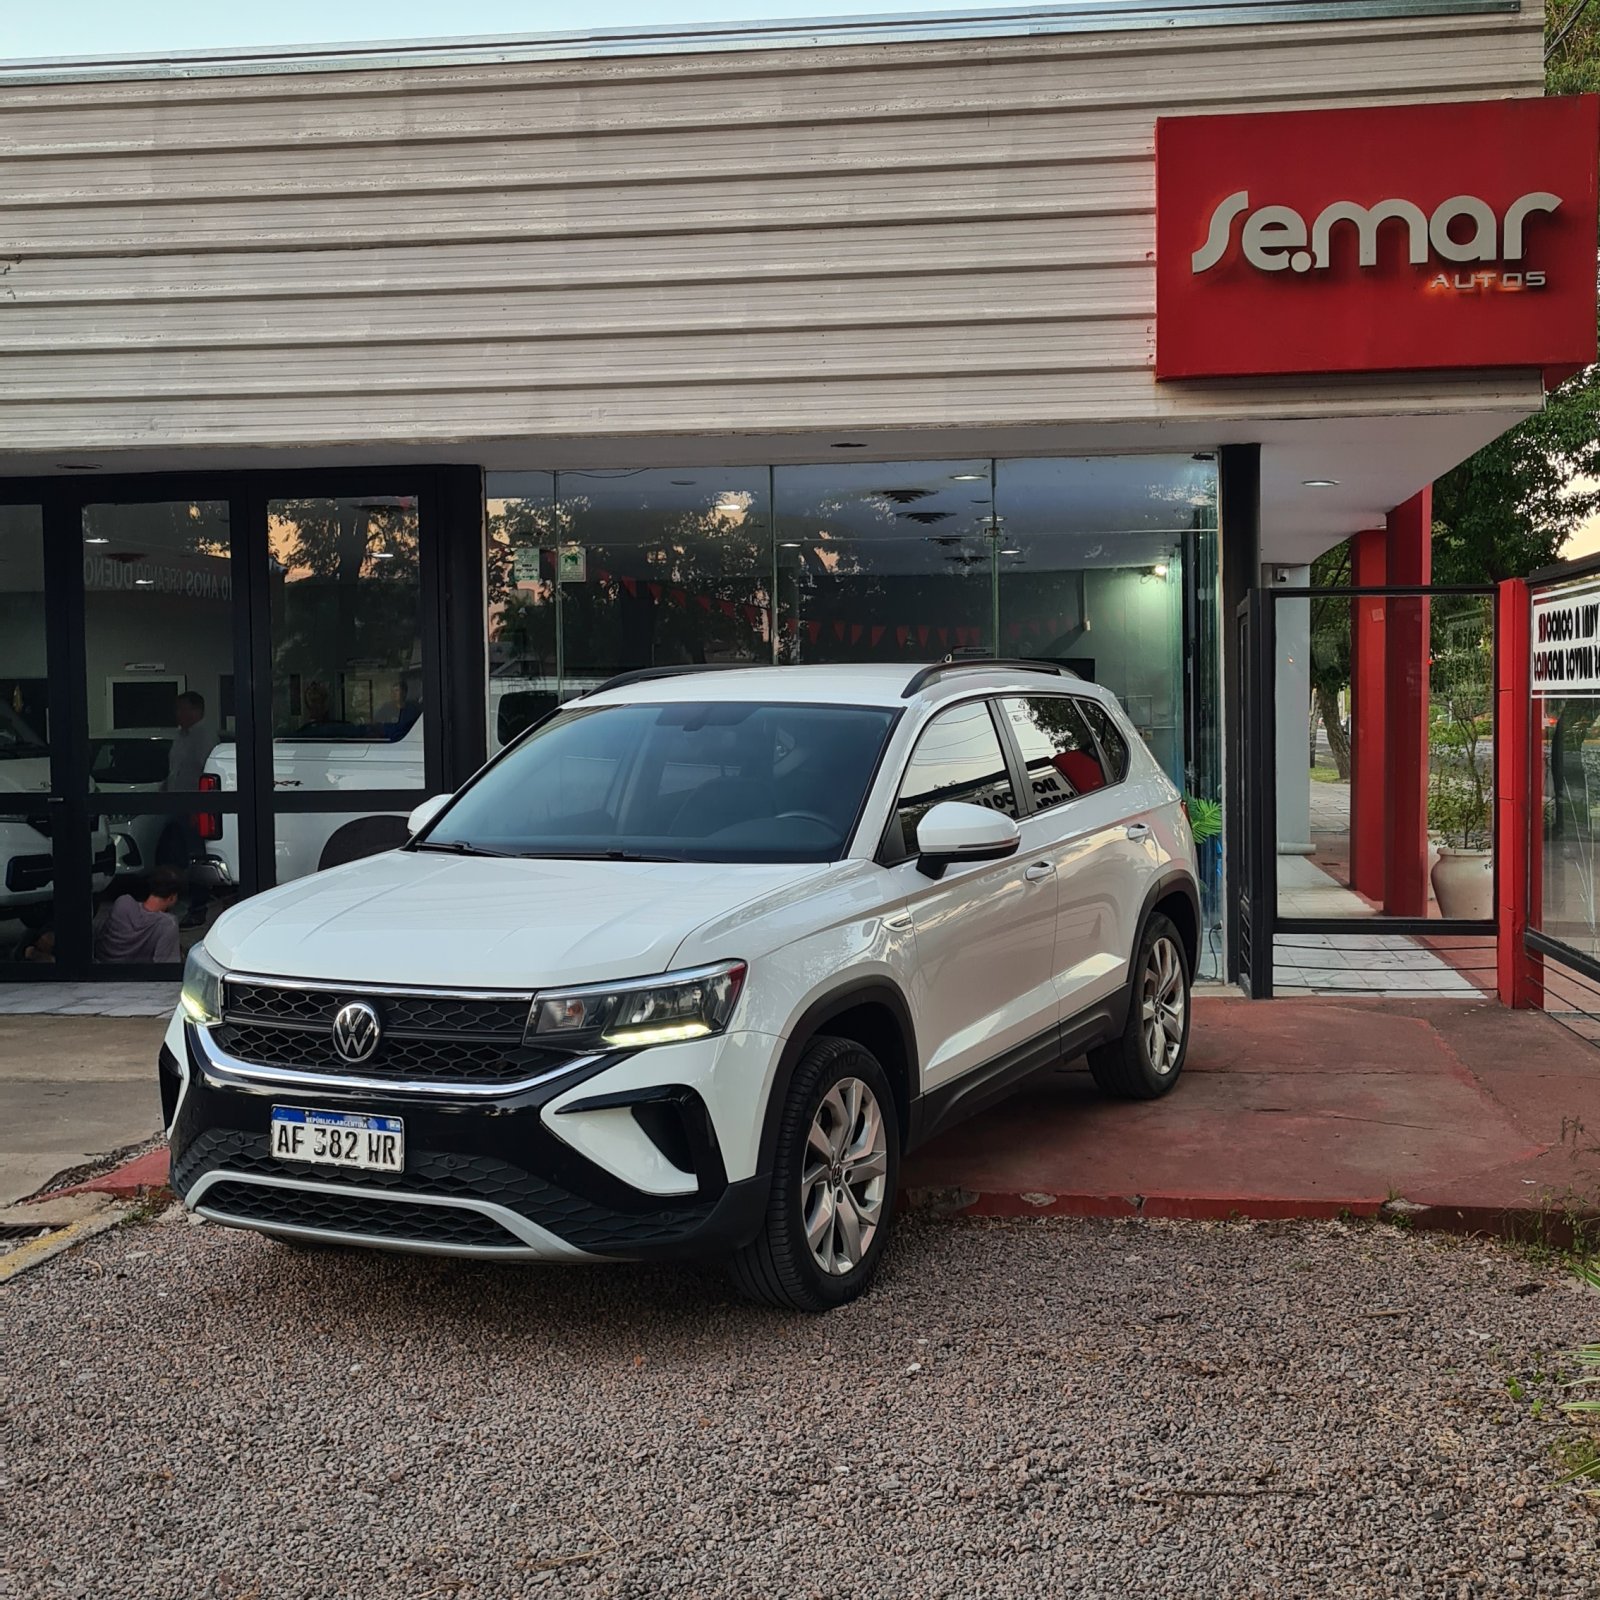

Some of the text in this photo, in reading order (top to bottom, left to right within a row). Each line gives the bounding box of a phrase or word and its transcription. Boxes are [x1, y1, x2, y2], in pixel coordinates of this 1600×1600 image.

[1430, 271, 1546, 289] AUTOS
[278, 1125, 304, 1154] AF
[313, 1128, 358, 1160] 382
